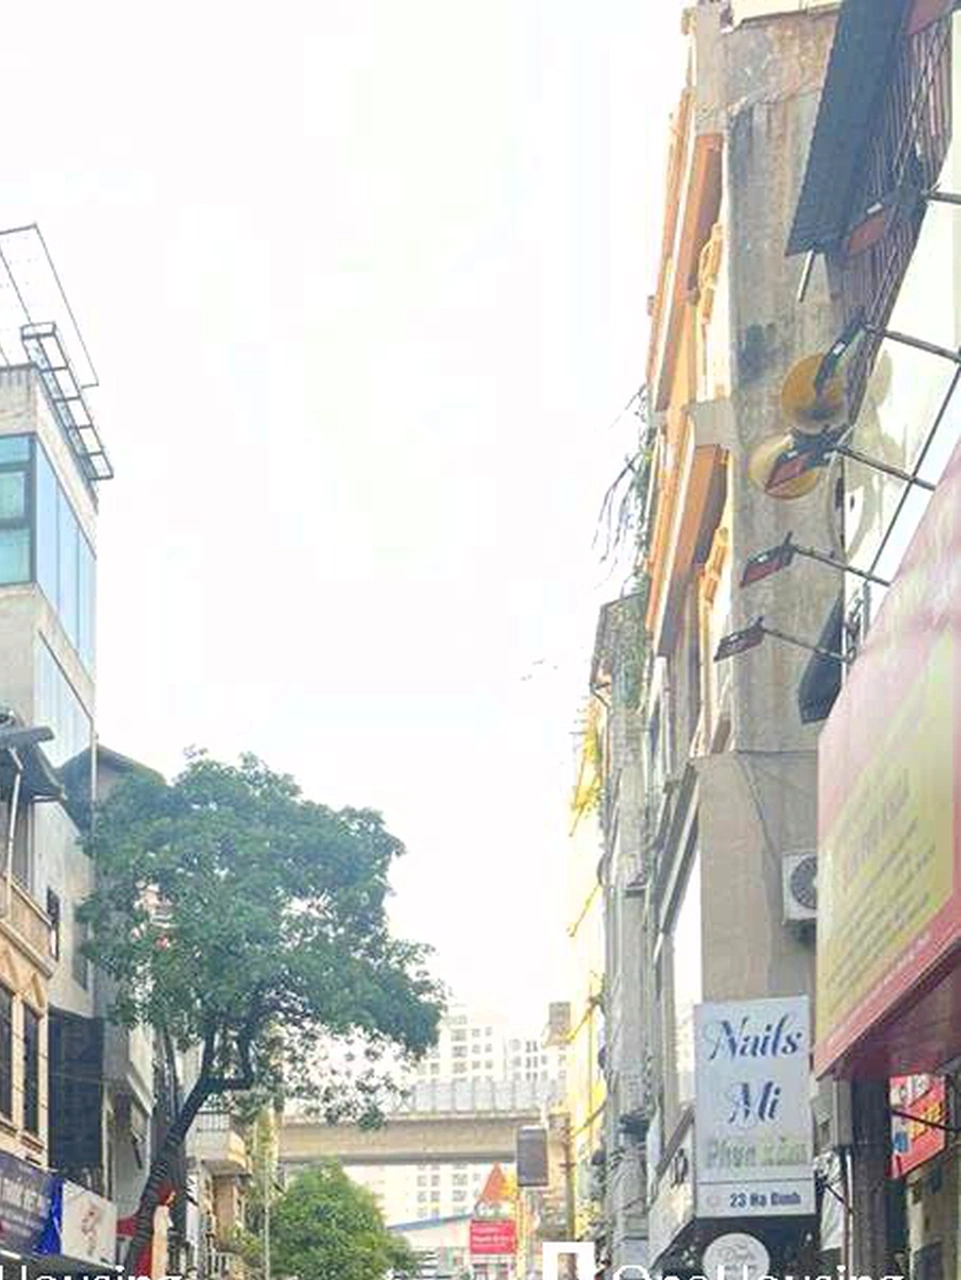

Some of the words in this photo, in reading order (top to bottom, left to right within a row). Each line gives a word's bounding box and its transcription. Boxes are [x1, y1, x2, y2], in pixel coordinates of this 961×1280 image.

[706, 1013, 804, 1061] Nails
[727, 1080, 782, 1126] Mi
[730, 1192, 747, 1208] 23
